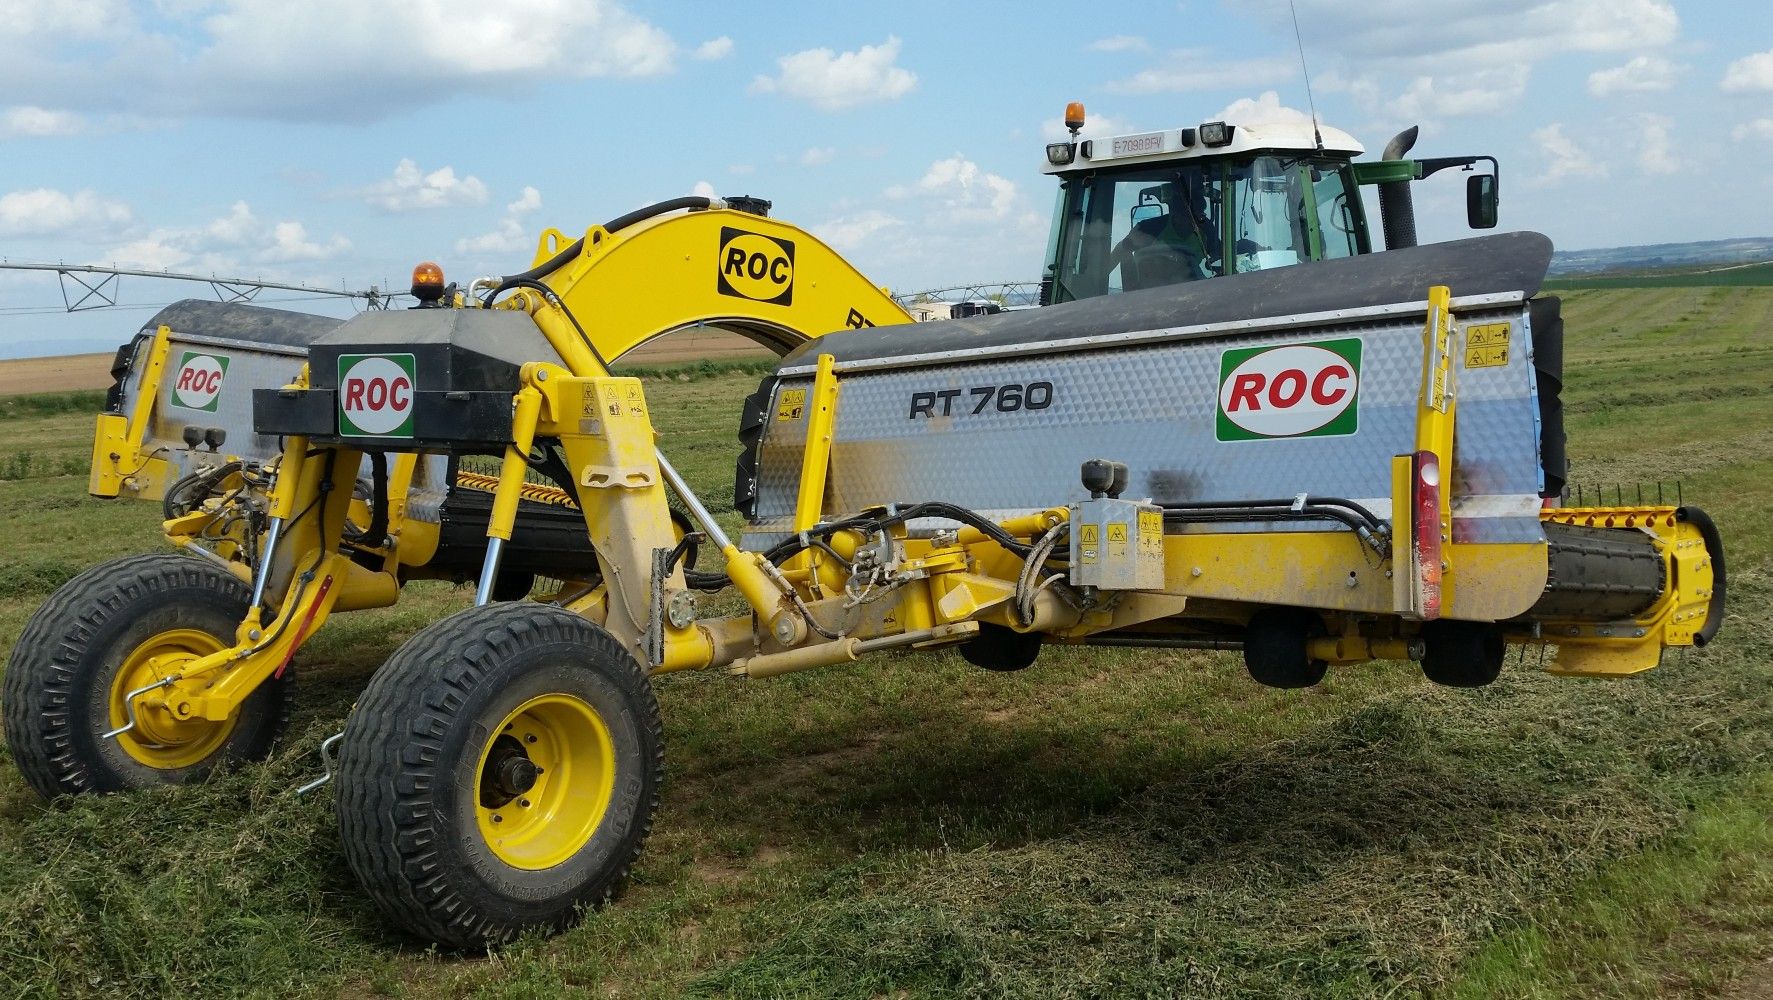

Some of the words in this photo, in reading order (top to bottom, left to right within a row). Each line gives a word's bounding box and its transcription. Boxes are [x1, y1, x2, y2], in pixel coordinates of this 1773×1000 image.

[724, 247, 789, 285] ROC
[846, 307, 876, 329] R
[176, 367, 222, 395] ROC
[345, 376, 410, 412] ROC
[1226, 364, 1350, 412] ROC
[909, 389, 962, 420] RT
[969, 381, 1053, 415] 760
